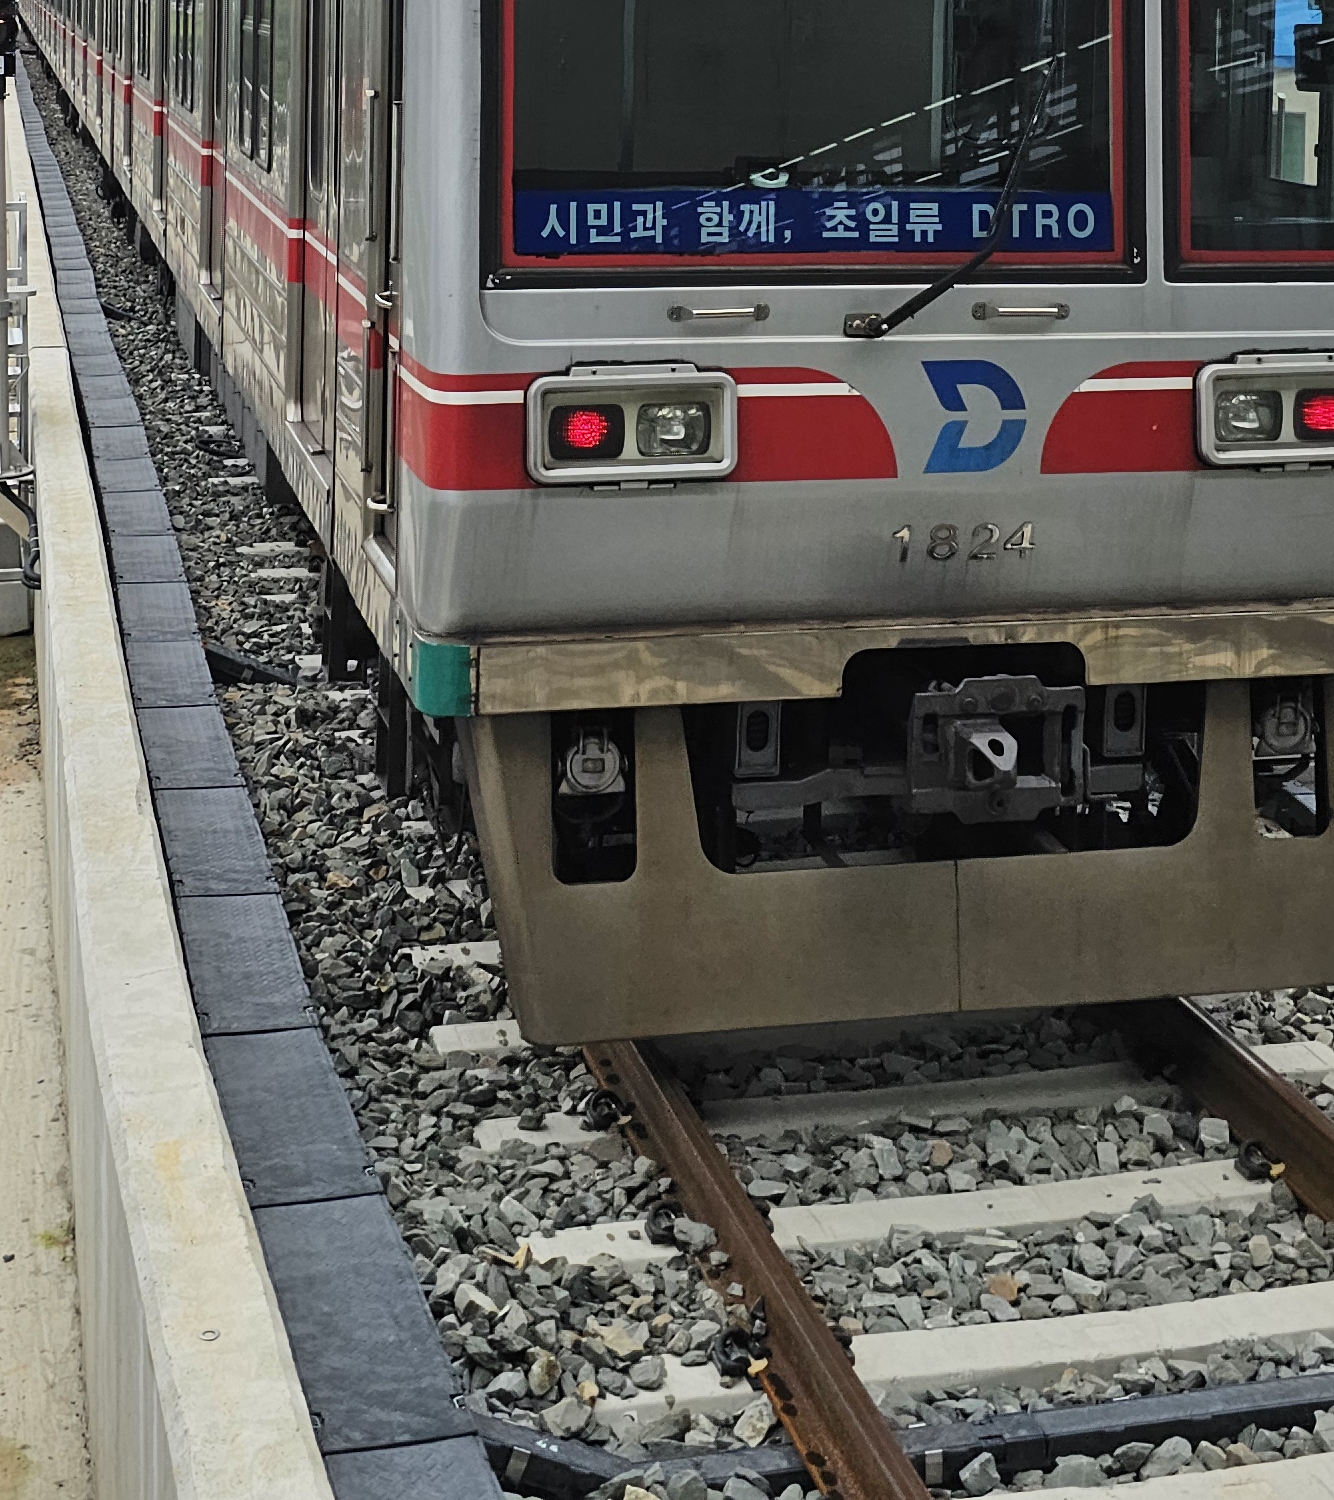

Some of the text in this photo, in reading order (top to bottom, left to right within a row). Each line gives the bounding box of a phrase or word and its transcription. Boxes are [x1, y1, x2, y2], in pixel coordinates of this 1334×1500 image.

[540, 200, 1096, 245] 시민과 함께, 초일류 DTRO
[891, 520, 1037, 563] 1824
